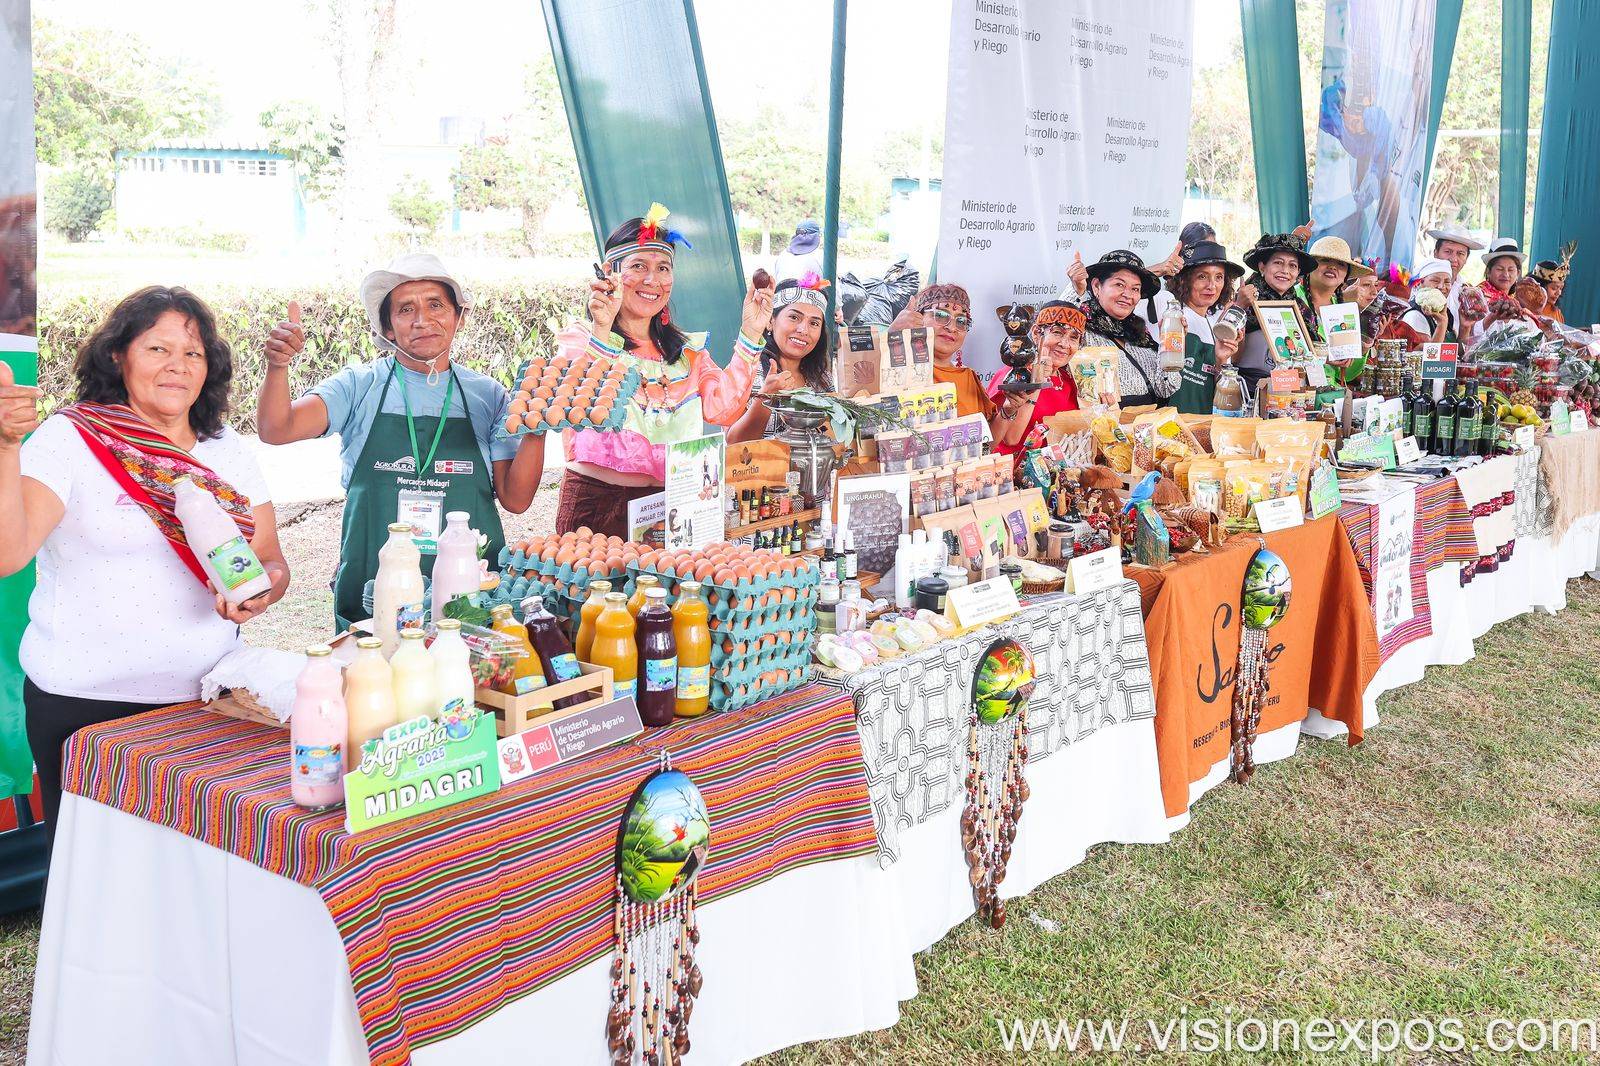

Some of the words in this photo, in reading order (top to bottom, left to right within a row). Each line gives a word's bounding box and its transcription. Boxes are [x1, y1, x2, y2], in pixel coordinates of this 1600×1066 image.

[975, 0, 1019, 17] Ministerio
[974, 18, 1020, 37] Desarrollo
[1104, 25, 1112, 36] de
[973, 39, 980, 51] y
[981, 38, 1008, 54] Riego
[1105, 41, 1128, 55] Agrario
[1069, 55, 1074, 66] y
[1147, 67, 1152, 78] y
[1152, 66, 1169, 80] Riego
[1059, 111, 1069, 122] de
[1106, 116, 1138, 131] Ministerio
[1138, 121, 1145, 131] de
[1105, 132, 1137, 147] Desarrollo
[1137, 136, 1159, 150] Agrario
[1024, 144, 1029, 156] y
[1103, 152, 1108, 162] y
[1108, 150, 1127, 163] Riego
[961, 199, 1005, 213] Ministerio
[1006, 202, 1017, 213] de
[1086, 205, 1095, 216] de
[960, 217, 1005, 231] Desarrollo
[1006, 219, 1035, 233] Agrario
[1130, 221, 1160, 233] Desarrollo
[958, 238, 964, 249] y
[966, 236, 992, 250] Riego
[1056, 240, 1060, 250] y
[1128, 240, 1132, 249] y
[1132, 237, 1149, 250] Riego
[1013, 284, 1049, 296] Ministerio
[427, 479, 450, 489] Midagri
[846, 493, 884, 502] UNGURAHUI
[389, 716, 429, 742] EXPO
[555, 718, 589, 736] Ministerio
[558, 735, 569, 746] de
[569, 725, 601, 745] Desarrollo
[601, 715, 625, 731] Agrario
[360, 723, 449, 779] Agraria
[528, 738, 552, 756] PERÚ
[560, 749, 566, 757] y
[566, 740, 586, 755] Riego
[417, 750, 445, 767] 2025
[364, 764, 484, 820] MIDAGRI
